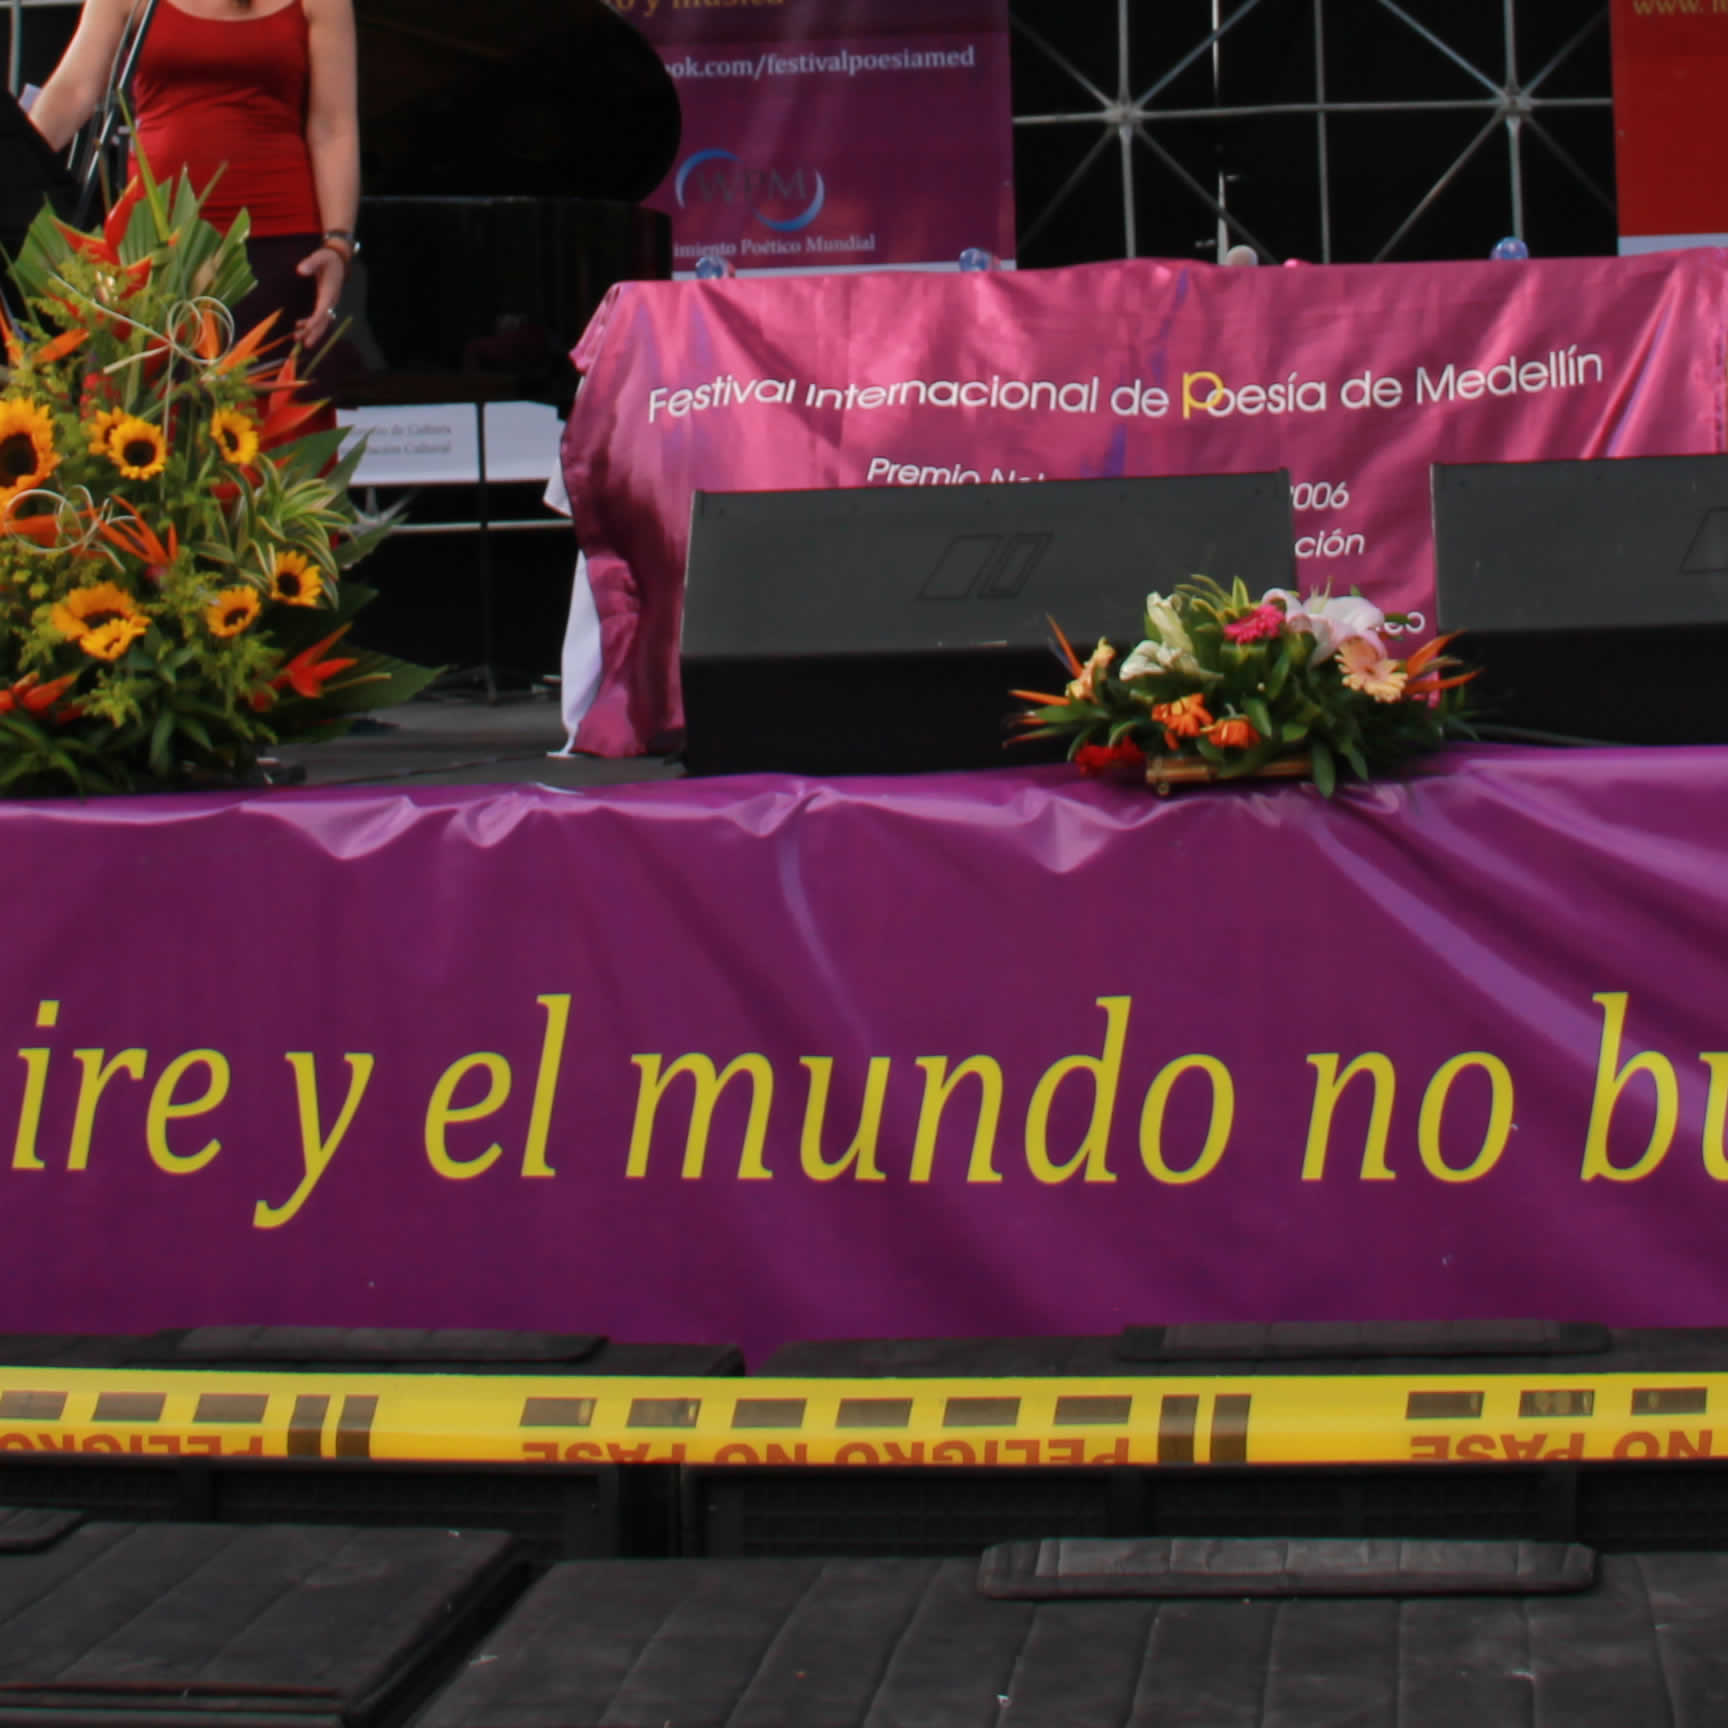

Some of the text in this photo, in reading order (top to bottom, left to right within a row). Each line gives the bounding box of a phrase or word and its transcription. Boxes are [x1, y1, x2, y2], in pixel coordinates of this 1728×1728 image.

[806, 231, 877, 254] Mundial
[649, 345, 1604, 423] Festival Internacional de Poesía de Medellín
[1290, 480, 1350, 512] 006
[253, 1051, 375, 1229] y
[424, 992, 573, 1180] el
[624, 994, 1236, 1185] mundo
[1301, 1050, 1515, 1183] no
[1613, 1429, 1713, 1460] NO
